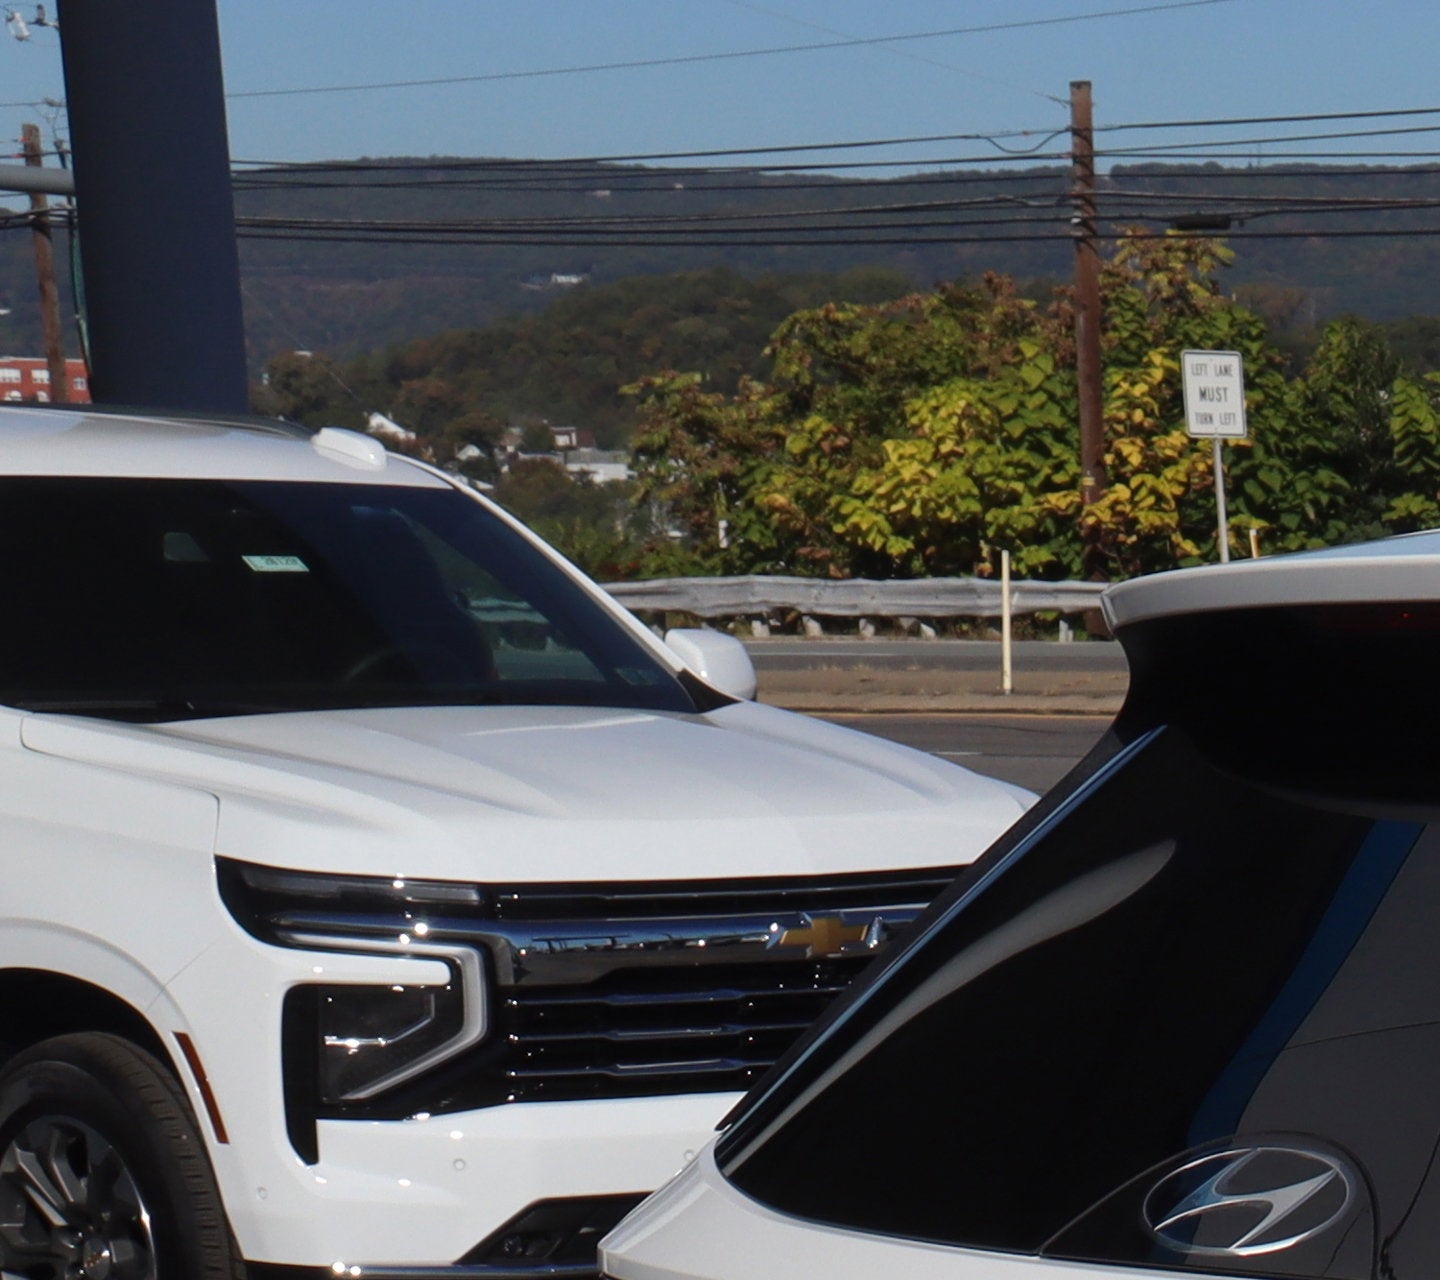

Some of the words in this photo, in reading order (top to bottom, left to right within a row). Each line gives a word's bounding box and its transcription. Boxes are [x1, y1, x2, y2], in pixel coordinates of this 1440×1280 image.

[1191, 363, 1207, 376] LEFT
[1214, 364, 1233, 377] LANE
[1199, 386, 1228, 402] MUST
[1194, 412, 1214, 425] TURN
[1219, 412, 1236, 425] LEFT
